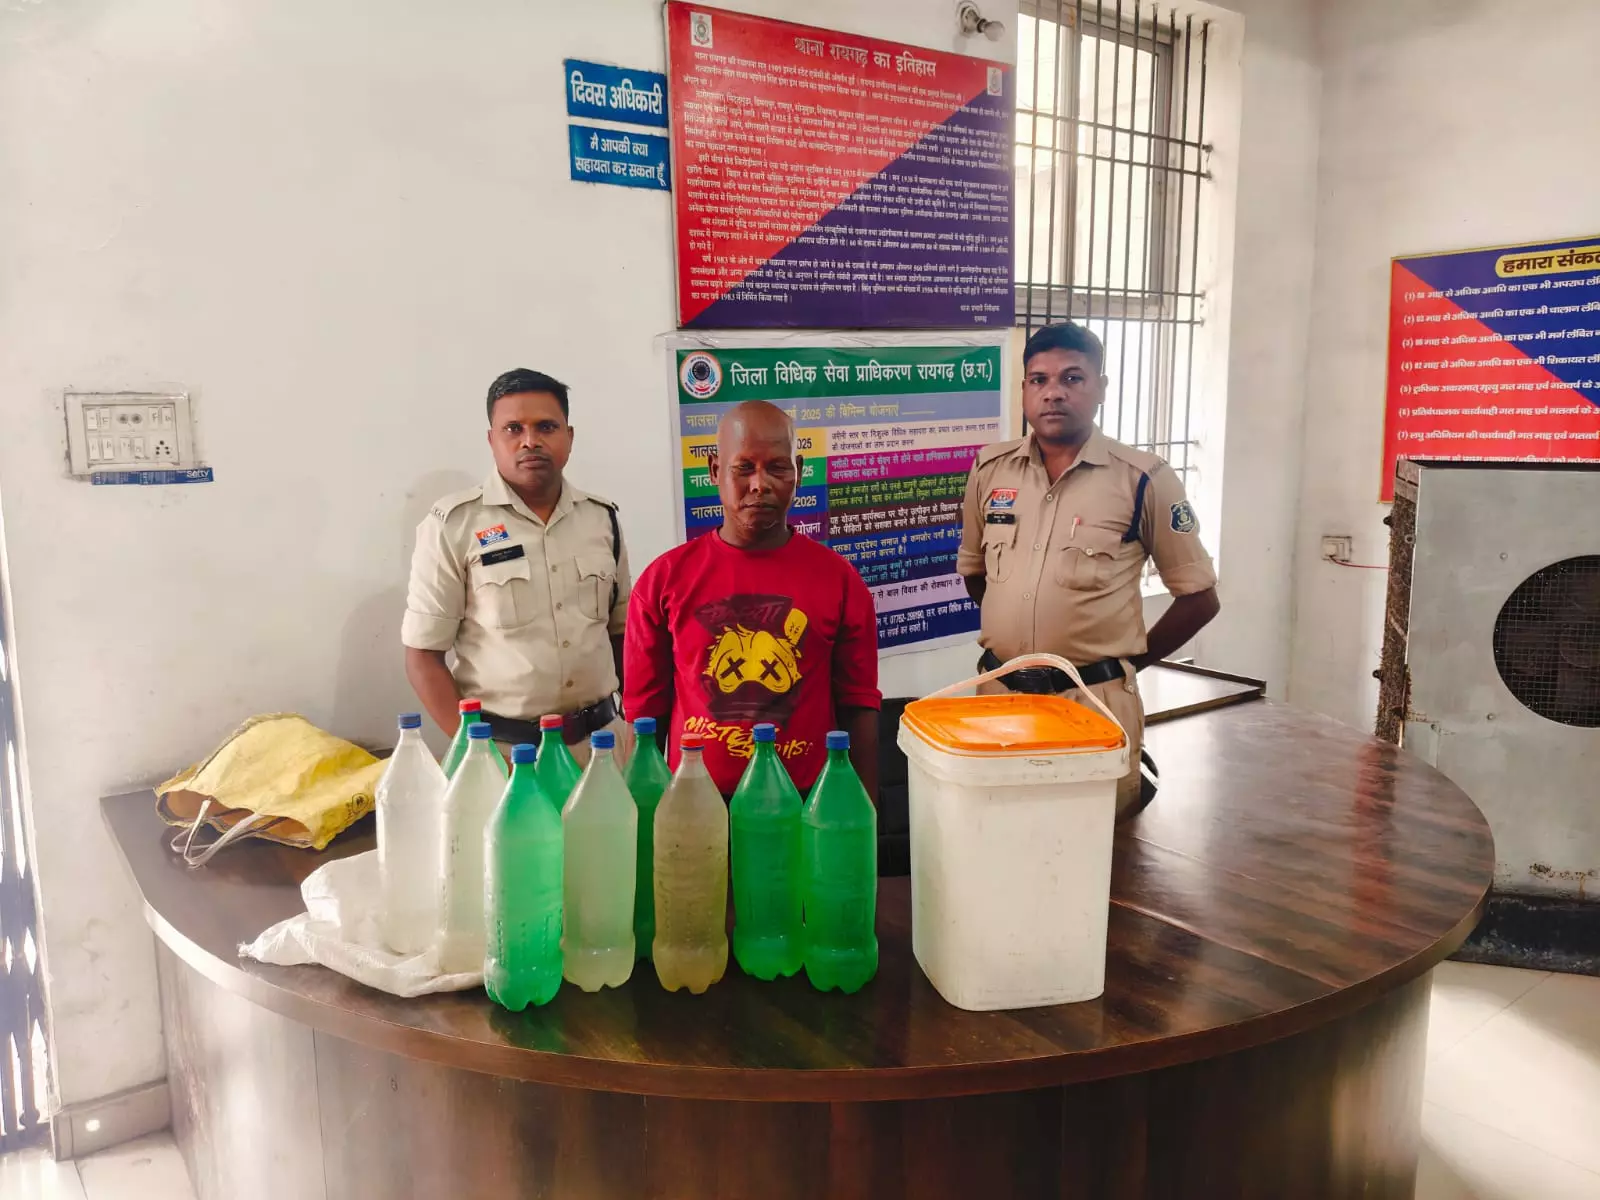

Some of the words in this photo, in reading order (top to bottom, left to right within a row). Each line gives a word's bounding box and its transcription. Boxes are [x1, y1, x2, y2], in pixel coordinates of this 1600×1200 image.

[794, 37, 824, 57] थाना
[873, 51, 891, 70] का
[896, 50, 937, 77] इतिहास
[570, 70, 607, 107] दिवस
[609, 78, 663, 115] अधिकारी
[601, 136, 631, 155] आपकी
[632, 141, 649, 158] क्या
[575, 155, 611, 174] सहायता
[612, 160, 627, 176] कर
[628, 162, 655, 179] सकता
[1503, 255, 1554, 273] हमारा
[730, 362, 768, 386] जिला
[773, 360, 817, 385] विधिक
[823, 359, 849, 383] सेवा
[855, 359, 912, 383] प्राधिकरण
[916, 363, 956, 383] रायगढ़
[960, 358, 993, 384] (छ.ग.)
[685, 413, 718, 428] नालसा
[800, 408, 822, 421] 2025
[825, 403, 836, 419] की
[689, 445, 718, 459] नालस
[793, 495, 817, 508] 2025
[841, 511, 859, 522] योजना
[861, 508, 885, 520] कार्यस्थल
[888, 510, 895, 518] पर
[794, 520, 821, 536] योजना
[830, 524, 840, 535] और
[864, 520, 872, 531] को
[909, 515, 916, 526] के
[880, 537, 898, 546] समाज
[902, 533, 907, 544] के
[860, 550, 876, 560] प्रदान
[879, 548, 895, 557] करना
[887, 588, 898, 597] बाल
[902, 583, 917, 595] विवाह
[920, 581, 928, 592] की
